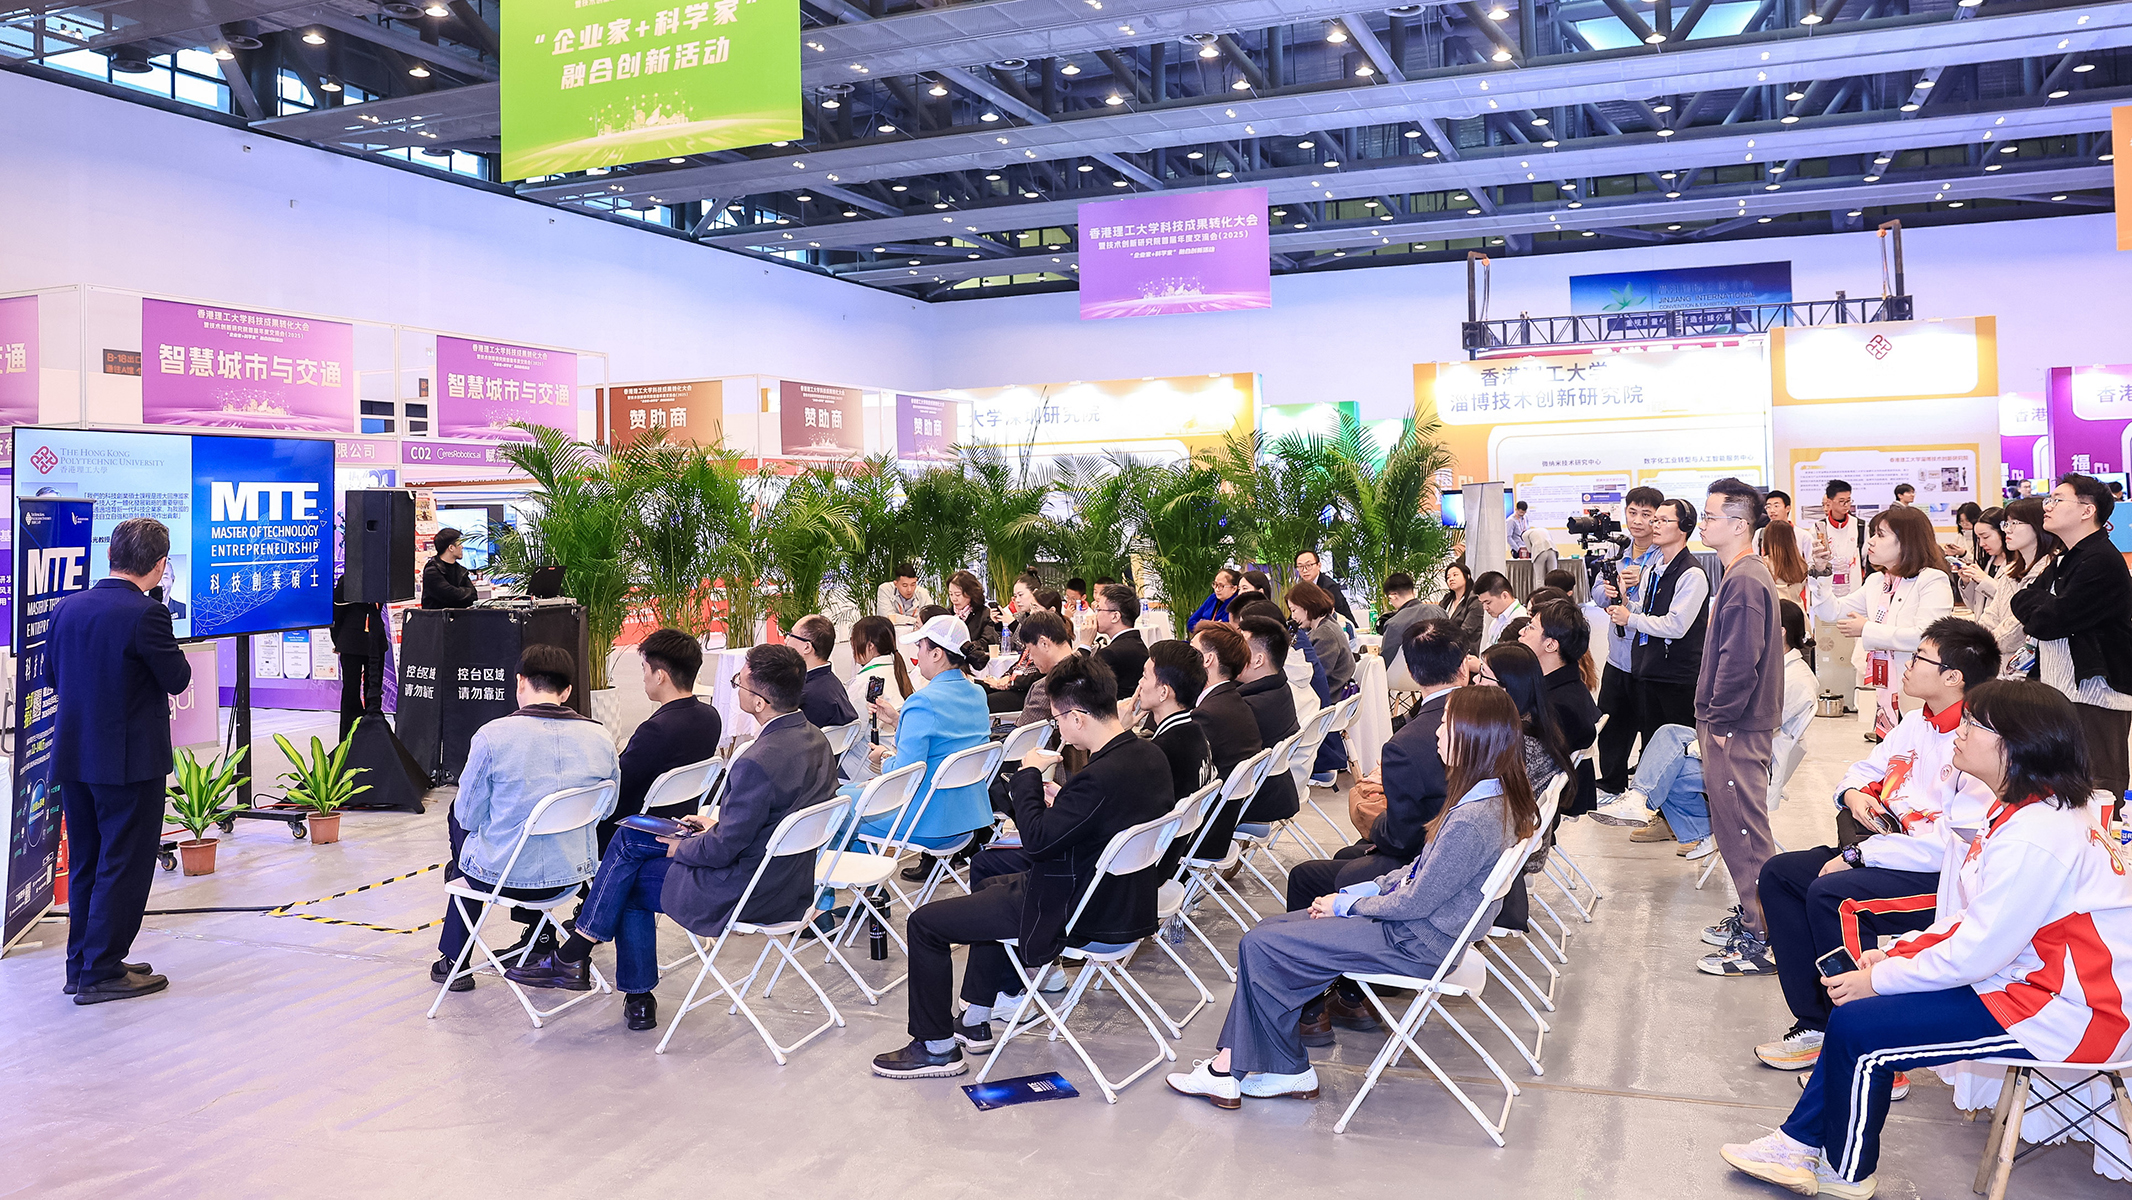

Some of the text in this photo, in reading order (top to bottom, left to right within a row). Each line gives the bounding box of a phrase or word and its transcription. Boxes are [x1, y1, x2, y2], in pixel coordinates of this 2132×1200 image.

[561, 36, 730, 90] 融合创新活动
[1089, 213, 1259, 240] 香港理工大学科技成果转化大会
[197, 308, 310, 332] 香港理工大学科技成果转化大会
[0, 343, 26, 374] 通
[159, 343, 342, 388] 智慧城市与交通
[1480, 361, 1608, 387] 香港工大学
[448, 372, 570, 407] 智慧城市与交通
[1450, 384, 1644, 412] 淄博技术创新研究院
[629, 407, 687, 430] 赞助商
[804, 406, 843, 430] 赞助商
[913, 417, 942, 437] 赞助商
[60, 447, 130, 458] THE HONG KONG
[60, 457, 165, 467] POLYTECHNIC UNIVERSITY
[410, 446, 432, 460] C02
[211, 481, 319, 522] MTE
[211, 525, 319, 540] MASTER OF TECHNOLOGY
[211, 541, 319, 557] ENTREPRENEURSHIP
[27, 546, 86, 596] MTE
[210, 568, 319, 594] 科技創業碩士
[406, 664, 436, 680] 控台区域
[457, 667, 505, 682] 控台区域
[404, 684, 434, 700] 请勿靠近
[458, 686, 505, 701] 请勿靠近
